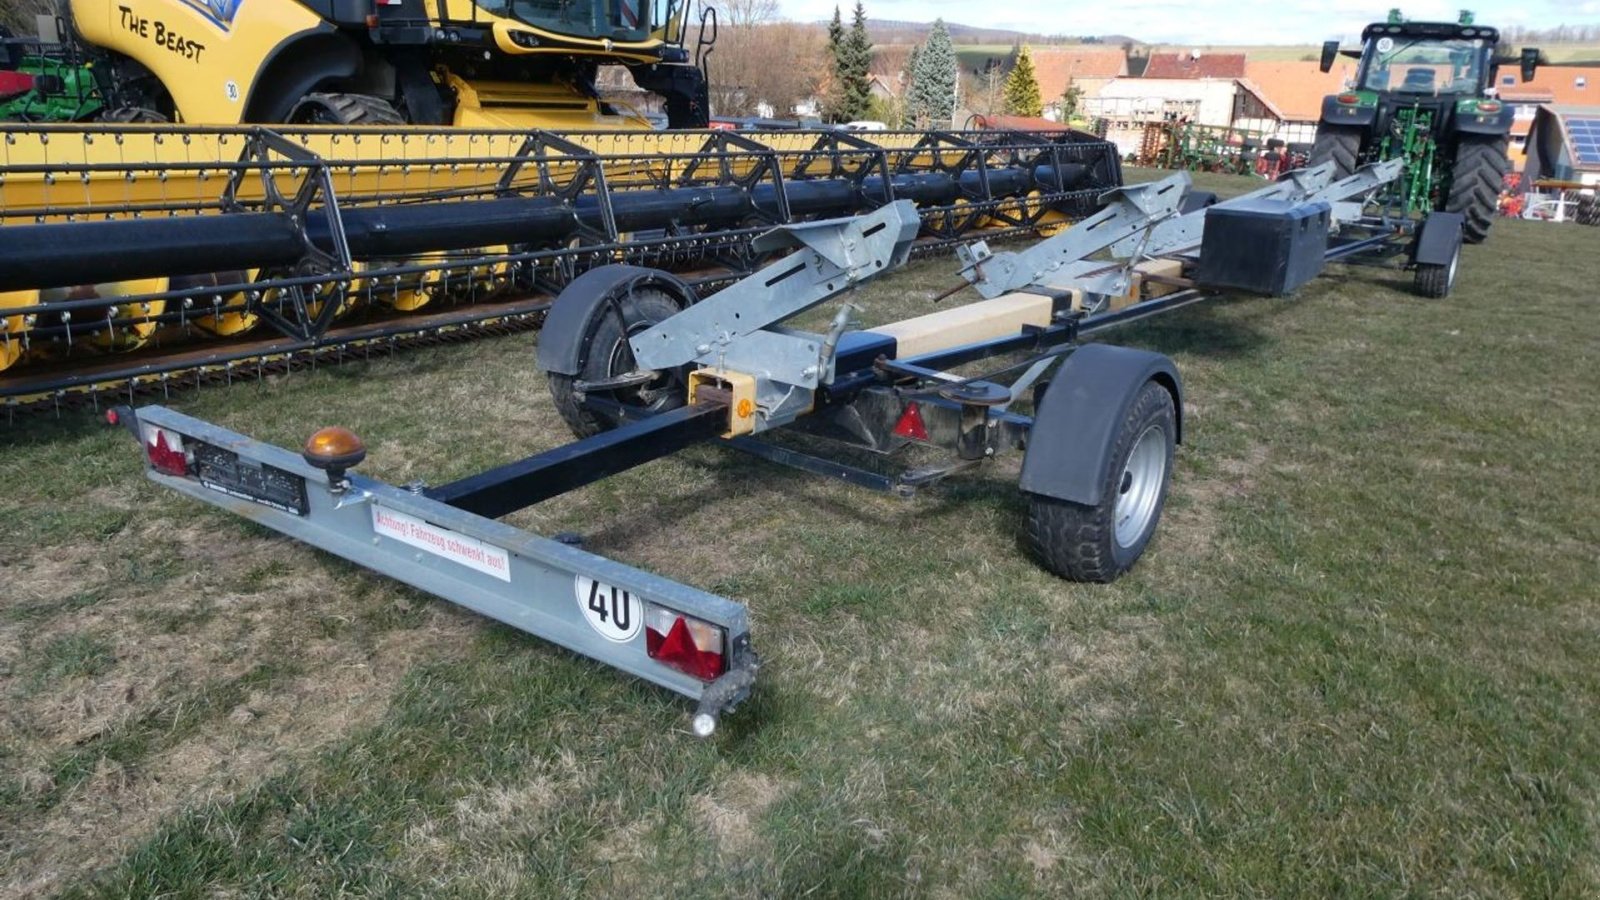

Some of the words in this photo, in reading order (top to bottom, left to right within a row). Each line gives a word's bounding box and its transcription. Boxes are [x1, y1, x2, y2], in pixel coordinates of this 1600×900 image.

[376, 511, 409, 537] Achtung!
[410, 524, 446, 551] Fahrzeug
[447, 541, 485, 563] schwenkt
[487, 554, 506, 571] aus!
[588, 580, 630, 631] 40
